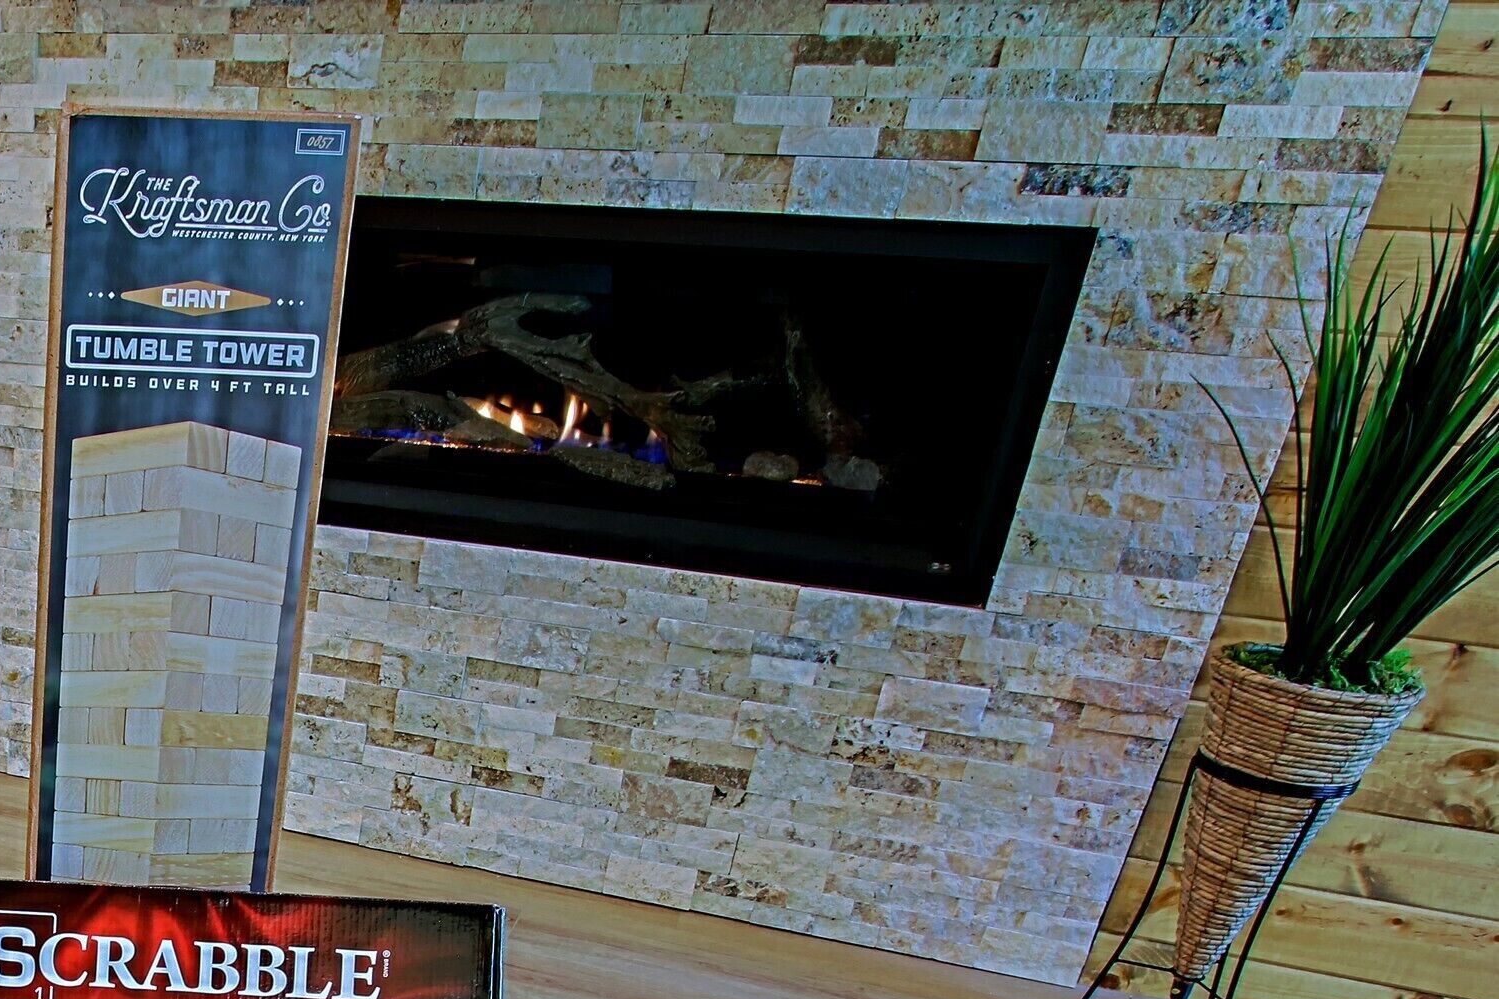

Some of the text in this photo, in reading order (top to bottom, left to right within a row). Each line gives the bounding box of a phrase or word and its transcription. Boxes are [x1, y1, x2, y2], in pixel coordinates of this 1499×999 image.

[146, 177, 173, 192] THE
[79, 167, 269, 238] Kraftsman
[172, 230, 234, 240] WESTCHESTER
[279, 234, 299, 242] NEW
[302, 235, 326, 243] YORK
[161, 288, 231, 309] GIANT
[75, 336, 306, 368] TUMBLE TOWER
[65, 374, 310, 396] BUILDS OVER 4 FT TALL
